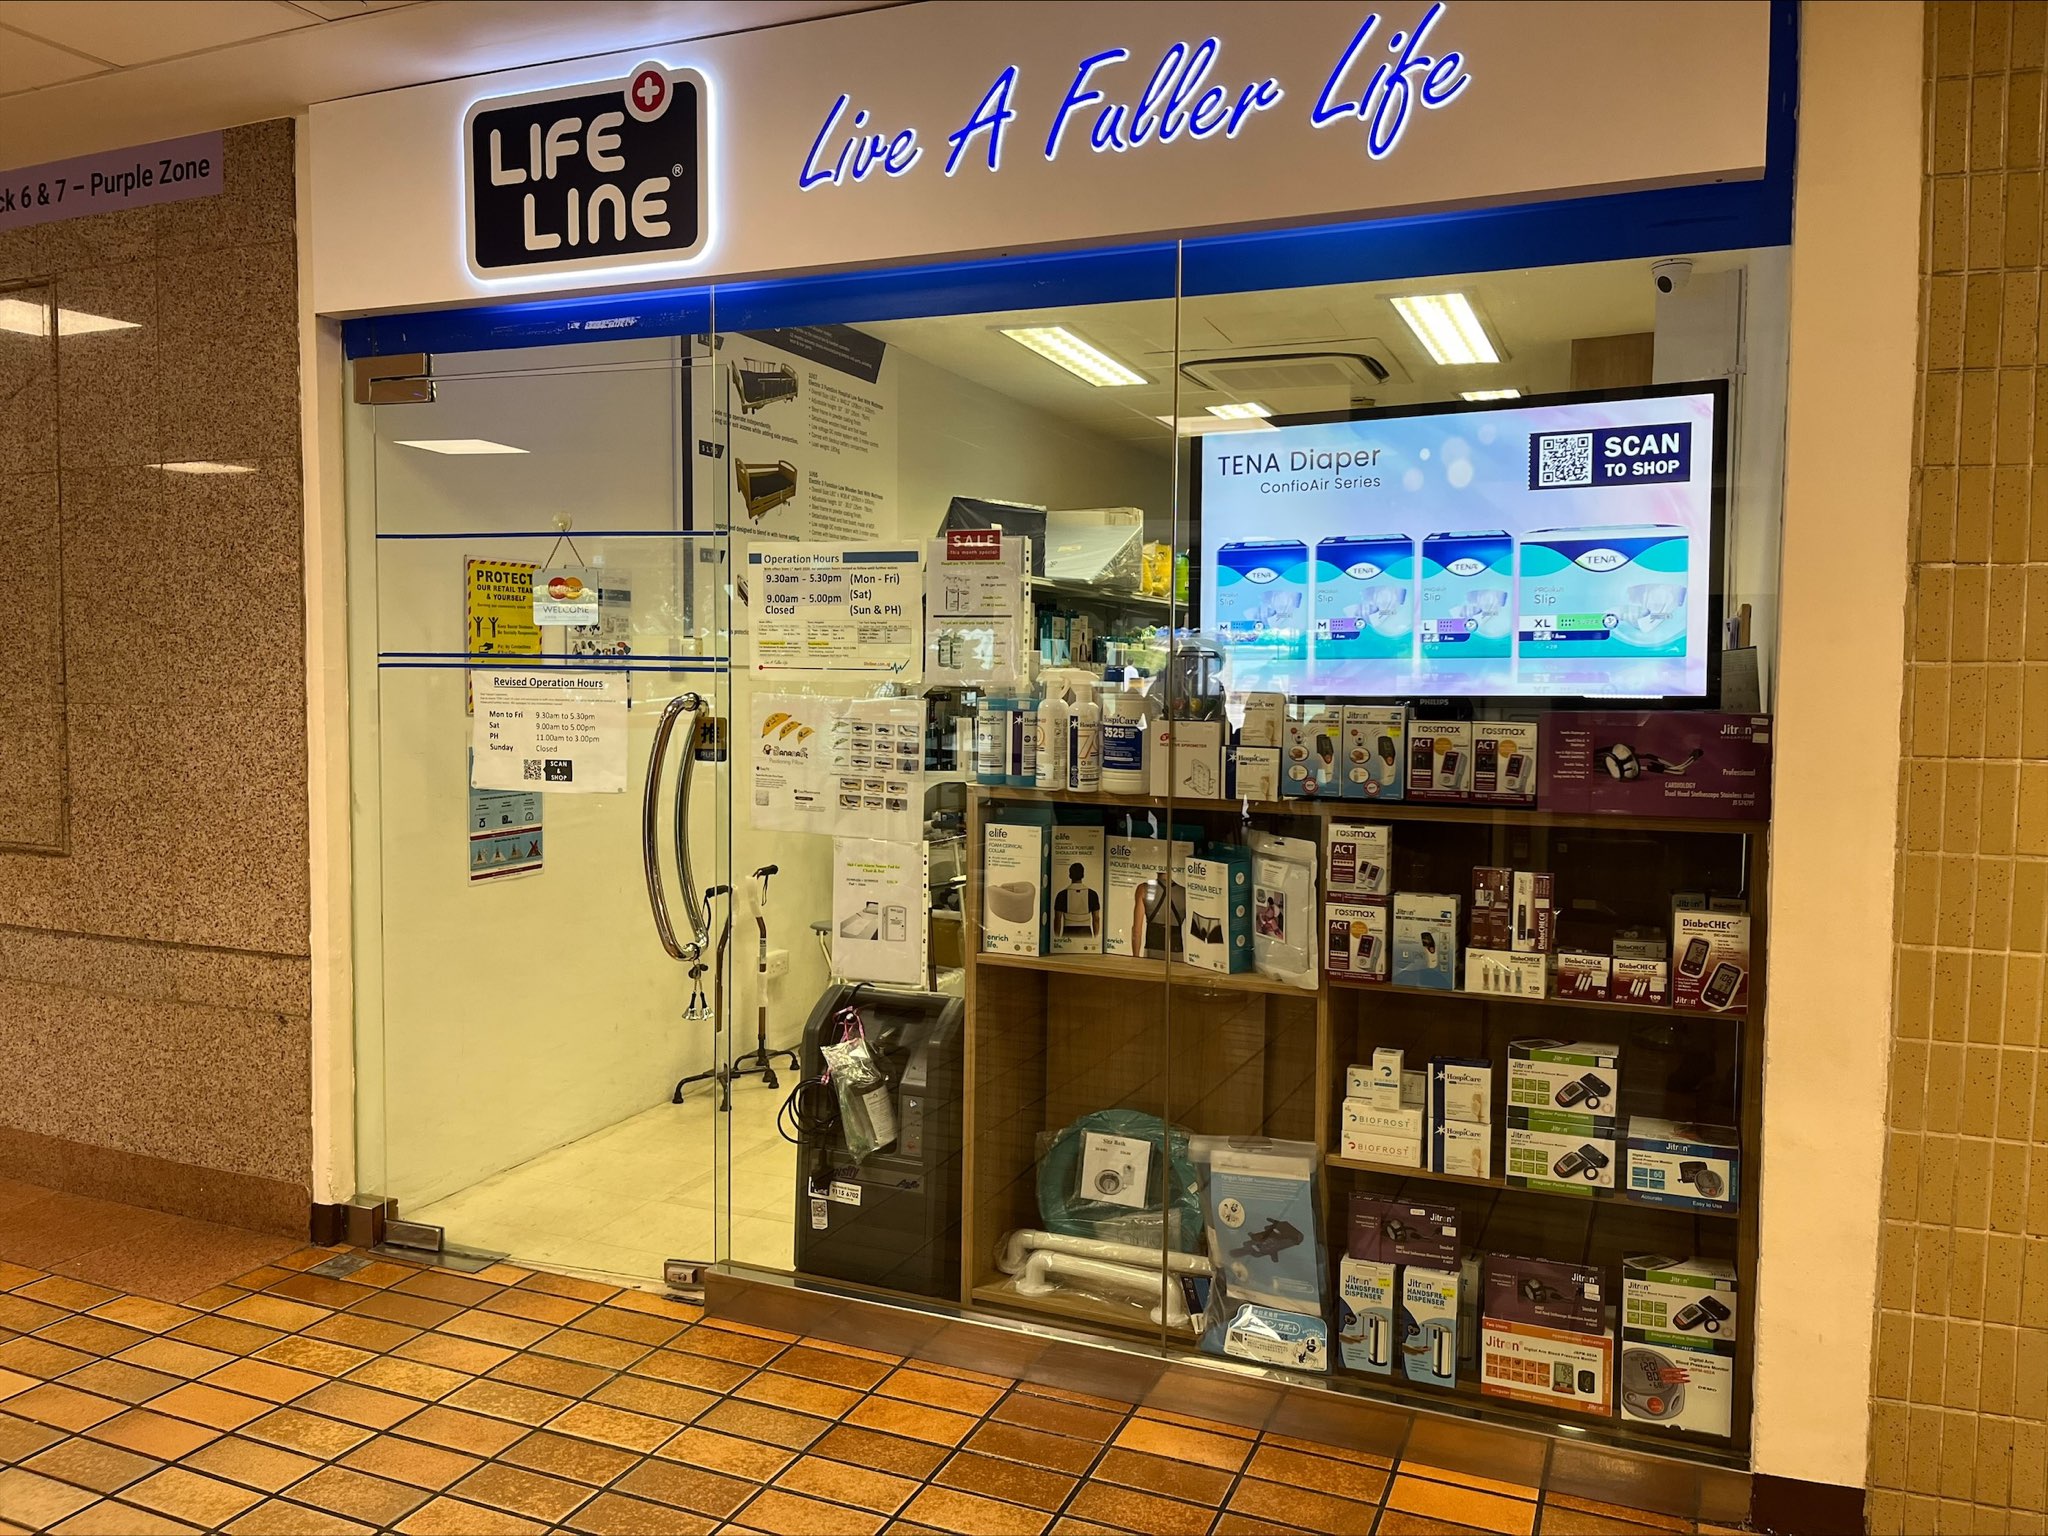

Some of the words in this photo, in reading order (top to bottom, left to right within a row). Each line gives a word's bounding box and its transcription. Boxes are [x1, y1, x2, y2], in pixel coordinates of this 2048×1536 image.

[800, 93, 923, 192] Live
[945, 64, 1021, 178] A
[1045, 36, 1285, 162] Fuller
[1311, 1, 1472, 160] Life
[490, 111, 626, 188] LIFE
[21, 185, 31, 208] 6
[37, 183, 50, 206] &
[55, 179, 66, 202] 7
[91, 164, 153, 197] Purple
[159, 158, 210, 184] Zone
[523, 176, 672, 251] LINE
[1604, 432, 1681, 458] SCAN
[1217, 454, 1281, 477] TENA
[1289, 446, 1382, 474] Diaper
[1605, 463, 1629, 478] TO
[1632, 459, 1681, 476] SHOP
[1260, 478, 1330, 495] ConfioAir
[1335, 475, 1381, 491] Series
[953, 535, 994, 547] SALE
[764, 554, 811, 565] Operation
[813, 554, 839, 563] Hours
[1585, 555, 1617, 565] TENA
[1353, 567, 1374, 575] TENA
[1454, 563, 1478, 571] TENA
[476, 569, 533, 585] PROTECT
[766, 574, 799, 583] 9.30am
[809, 573, 842, 584] 5.30pm
[850, 573, 875, 585] (Mon
[884, 573, 900, 585] Fri)
[493, 585, 516, 593] RETAIL
[493, 594, 527, 602] YOURSELF
[766, 594, 798, 603] 9.00am
[809, 594, 842, 604] 5.00pm
[850, 589, 872, 601] (Sat)
[1317, 595, 1334, 604] Slip
[1423, 593, 1441, 602] Slip
[1534, 594, 1556, 605] Slip
[1219, 598, 1234, 606] Slip
[542, 605, 590, 614] WELCOME
[765, 606, 795, 615] Closed
[849, 605, 871, 616] (Sun
[874, 605, 881, 614] &
[885, 605, 902, 616] PH)
[1220, 623, 1228, 631] M
[1317, 622, 1327, 630] M
[1534, 619, 1551, 628] XL
[494, 677, 527, 687] Revised
[529, 678, 575, 688] Operation
[577, 678, 603, 688] Hours
[1420, 698, 1449, 706] PHILIPS
[535, 712, 559, 720] 9.30am
[570, 713, 595, 721] 5.30pm
[570, 724, 595, 732] 5.00pm
[1104, 727, 1125, 739] 3525
[1418, 725, 1461, 733] rossmax
[1482, 727, 1526, 736] rossmax
[536, 734, 564, 742] 11.00am
[575, 735, 600, 743] 3.00pm
[490, 743, 513, 751] Sunday
[1413, 740, 1432, 748] ACT
[1477, 741, 1496, 750] ACT
[1238, 754, 1270, 762] HospiCare
[1722, 768, 1756, 777] Professional
[1691, 791, 1720, 799] Stethoscope
[1720, 791, 1742, 799] Stainless
[988, 828, 1008, 839] elife
[1055, 833, 1071, 841] elife
[1336, 829, 1377, 838] rossmax
[1110, 845, 1131, 857] elife
[1333, 844, 1354, 854] ACT
[1110, 861, 1141, 870] INDUSTRIAL
[1158, 866, 1186, 874] SUORT
[1188, 862, 1207, 876] elife
[1188, 883, 1208, 893] HERNIA
[1208, 886, 1223, 895] BELT
[1335, 908, 1375, 918] rossmax
[1331, 921, 1349, 930] ACT
[1538, 912, 1548, 950] DiabeCHECK
[986, 934, 1009, 942] enrich
[1107, 937, 1124, 945] enrich
[986, 941, 998, 949] life.
[1446, 1073, 1482, 1083] HospiCare
[1359, 1115, 1410, 1128] BIOFROST
[1446, 1127, 1482, 1138] HospiCare
[1358, 1143, 1408, 1156] BIOFROST
[1653, 1171, 1663, 1179] 60
[831, 1188, 845, 1196] 9115
[846, 1189, 859, 1199] 6702
[1640, 1194, 1663, 1202] Accurate
[1692, 1200, 1705, 1208] Easy
[1345, 1274, 1370, 1286] Jitron
[1407, 1278, 1432, 1290] Jitron
[1345, 1284, 1385, 1295] HANDSFREE
[1345, 1290, 1382, 1301] DISPENSER
[1407, 1294, 1445, 1307] DISPENSER
[1485, 1335, 1520, 1352] Jitron
[1523, 1346, 1537, 1354] Digital
[1560, 1352, 1580, 1360] Pressure
[1580, 1355, 1597, 1363] Monitor
[1688, 1356, 1704, 1364] Digital
[1689, 1361, 1711, 1370] Pressure
[1711, 1365, 1730, 1373] Monitor
